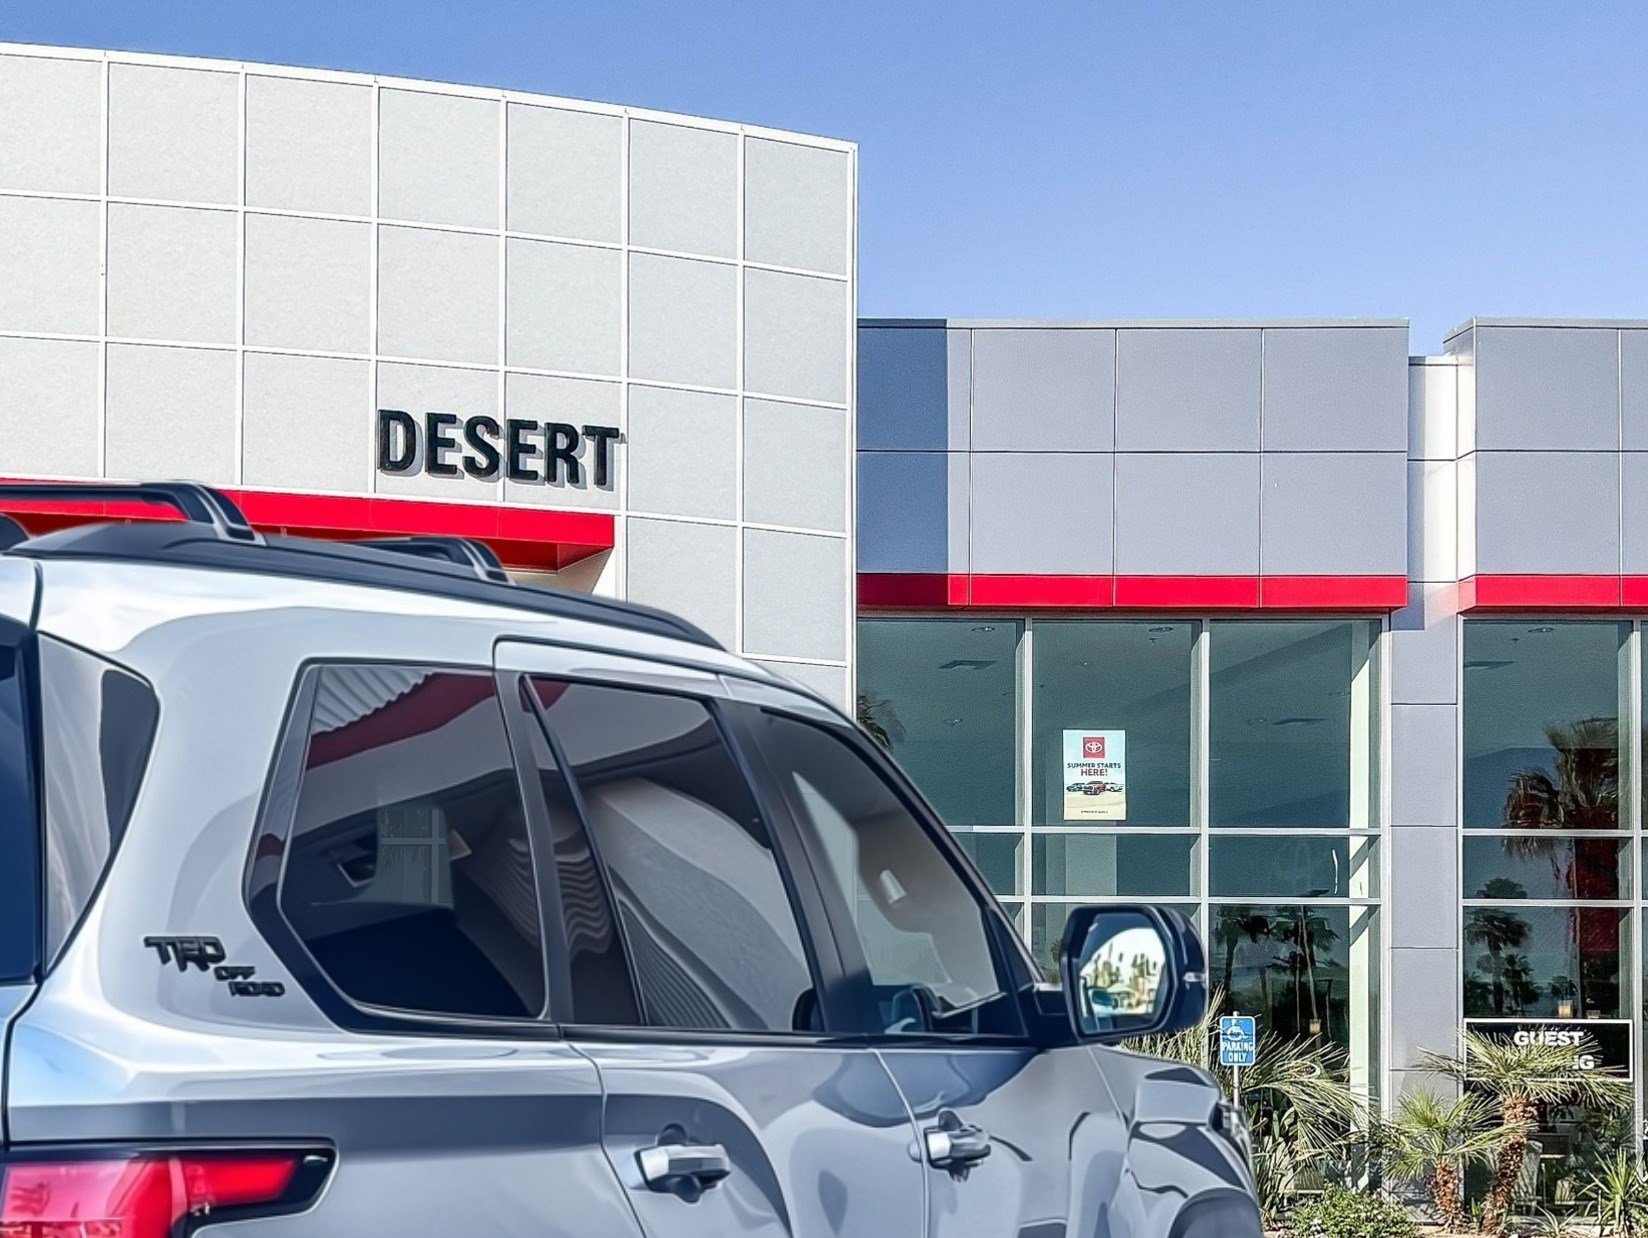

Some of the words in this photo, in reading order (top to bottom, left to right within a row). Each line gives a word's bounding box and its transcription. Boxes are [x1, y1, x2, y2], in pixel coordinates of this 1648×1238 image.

[377, 409, 620, 487] DESERT
[1080, 769, 1108, 777] HERE!
[143, 935, 227, 973] TRD
[1514, 1030, 1584, 1047] GUEST
[1222, 1041, 1254, 1052] PARKING
[1228, 1052, 1247, 1063] ONLY
